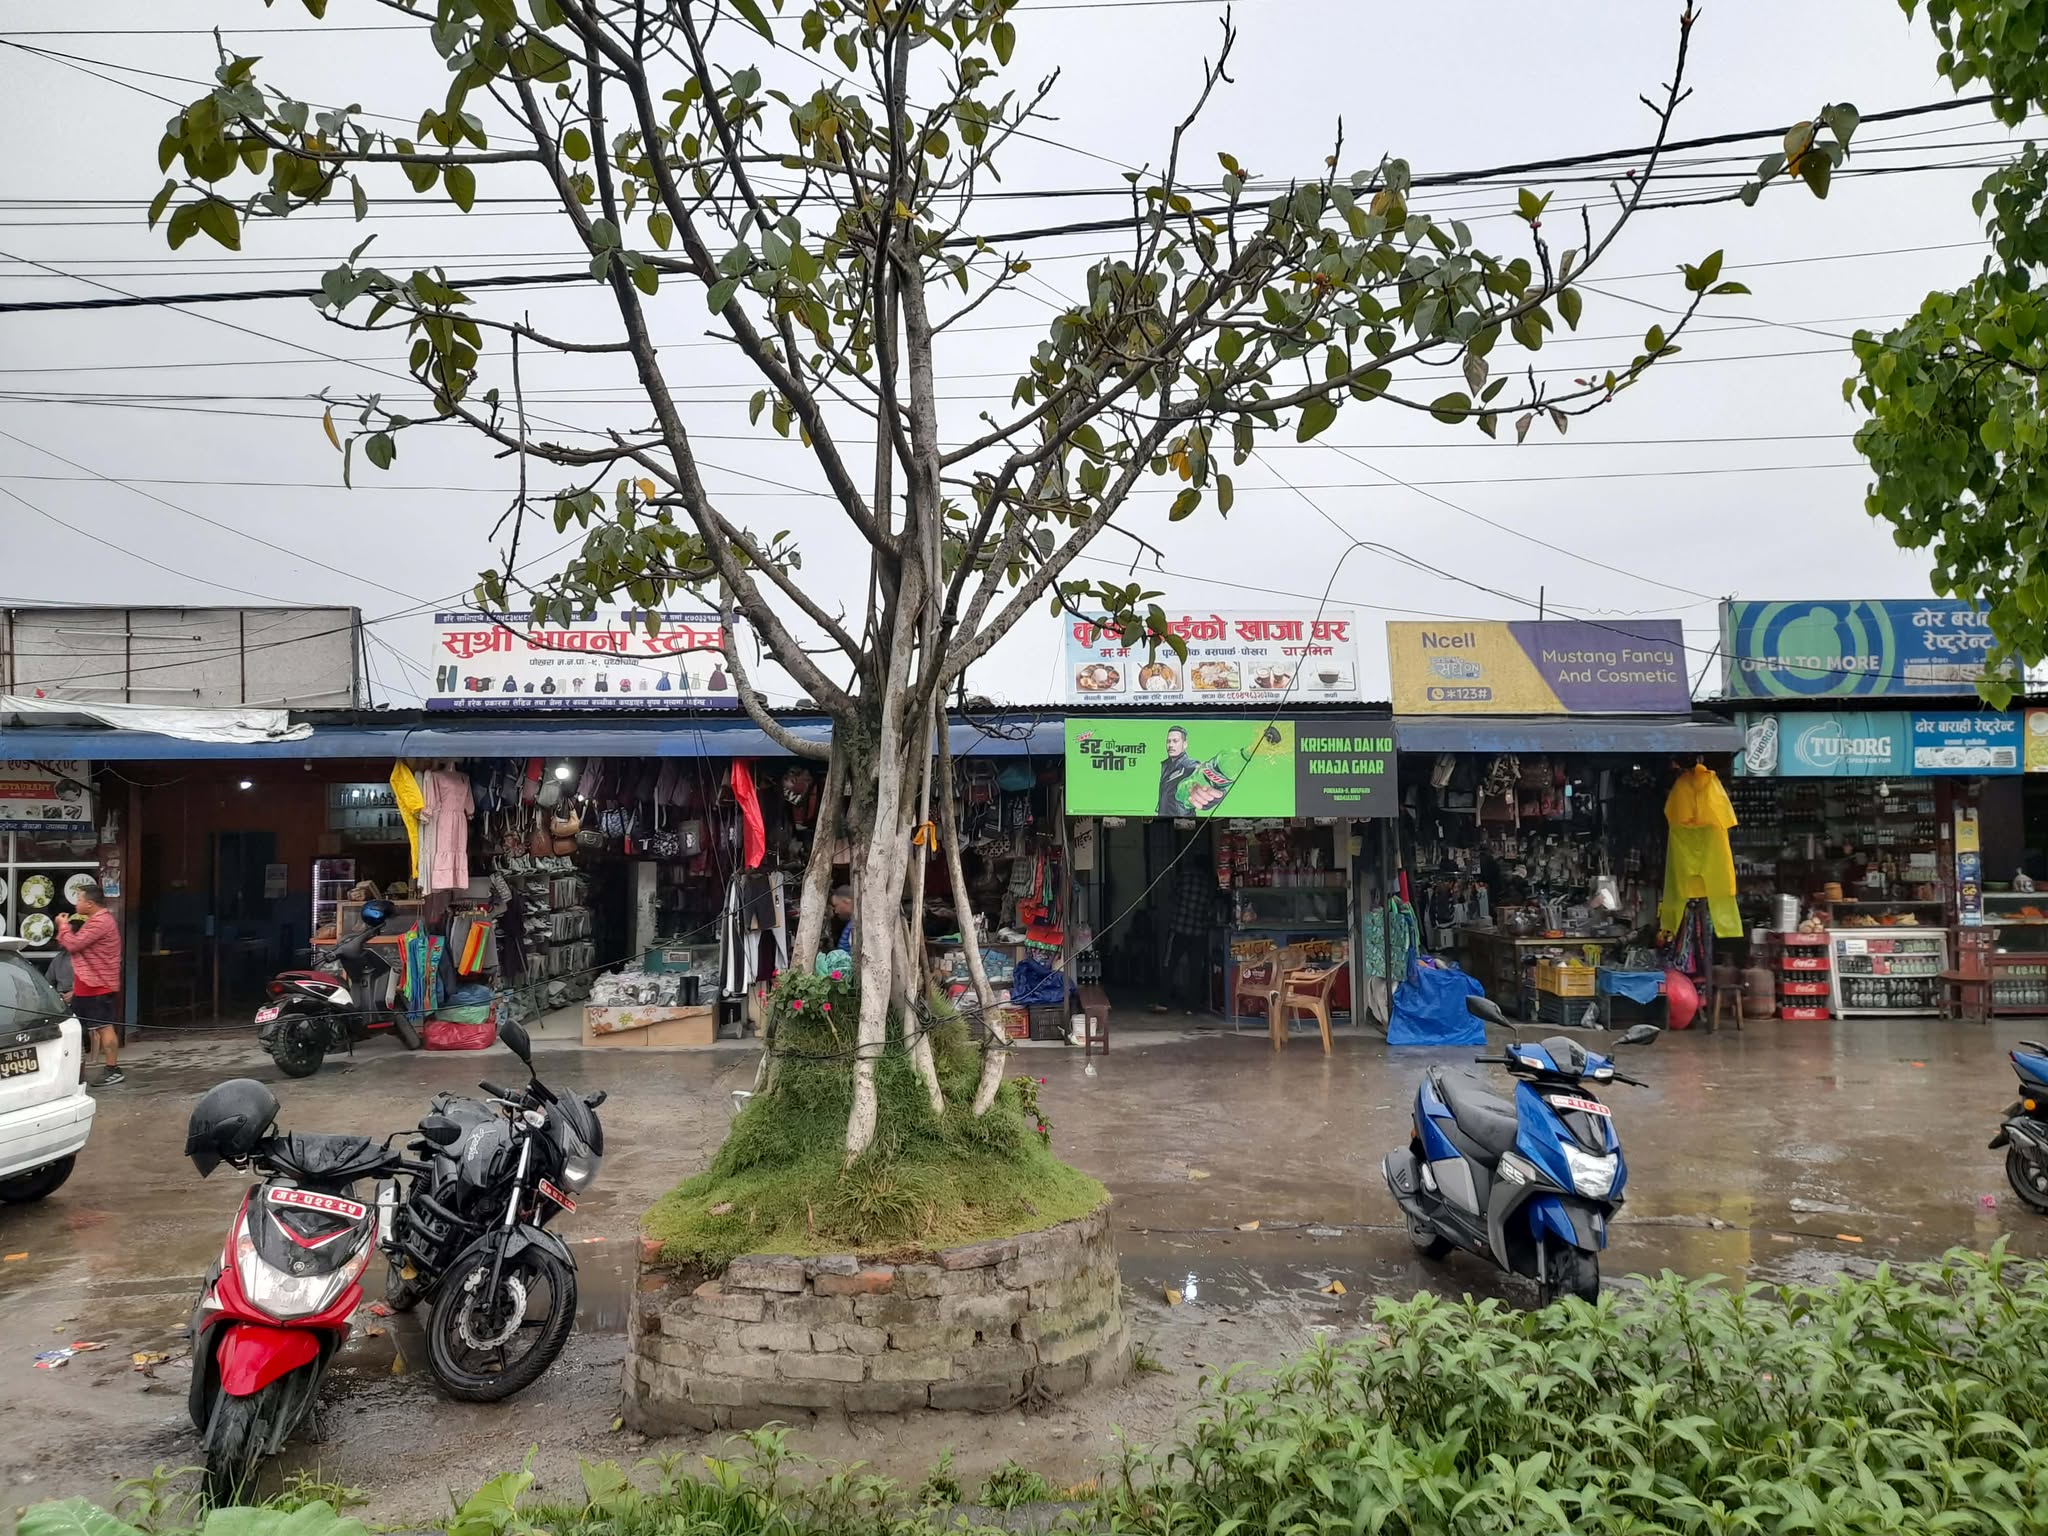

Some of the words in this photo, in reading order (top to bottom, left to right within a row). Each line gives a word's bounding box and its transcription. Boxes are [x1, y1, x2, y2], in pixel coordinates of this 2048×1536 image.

[1912, 608, 1946, 628] ढोर
[1234, 619, 1304, 643] खाजा
[1310, 619, 1350, 643] घर
[442, 625, 512, 659] सुश्री
[526, 629, 631, 652] भावना
[1422, 631, 1476, 649] Ncell
[1204, 646, 1237, 657] बसपार्क
[1241, 645, 1268, 657] पोखरा
[1542, 649, 1616, 666] Mustang
[1622, 649, 1675, 666] Fancy
[1741, 656, 1792, 672] OPEN
[1795, 656, 1825, 672] TO
[1827, 656, 1880, 672] MORE
[1558, 669, 1592, 684] And
[1597, 669, 1678, 684] Cosmetic
[1915, 718, 1937, 733] ढोर
[1080, 739, 1103, 754] डर
[1300, 737, 1352, 752] KRISHNA
[1354, 737, 1374, 752] DAI
[1375, 737, 1393, 752] KO
[1749, 729, 1775, 766] TUBORG
[1810, 736, 1892, 757] TUBORG
[1090, 750, 1127, 771] जीत
[1128, 757, 1138, 767] छ
[1309, 759, 1350, 774] KHAJA
[1351, 759, 1385, 774] GHAR
[1502, 1159, 1526, 1186] 125
